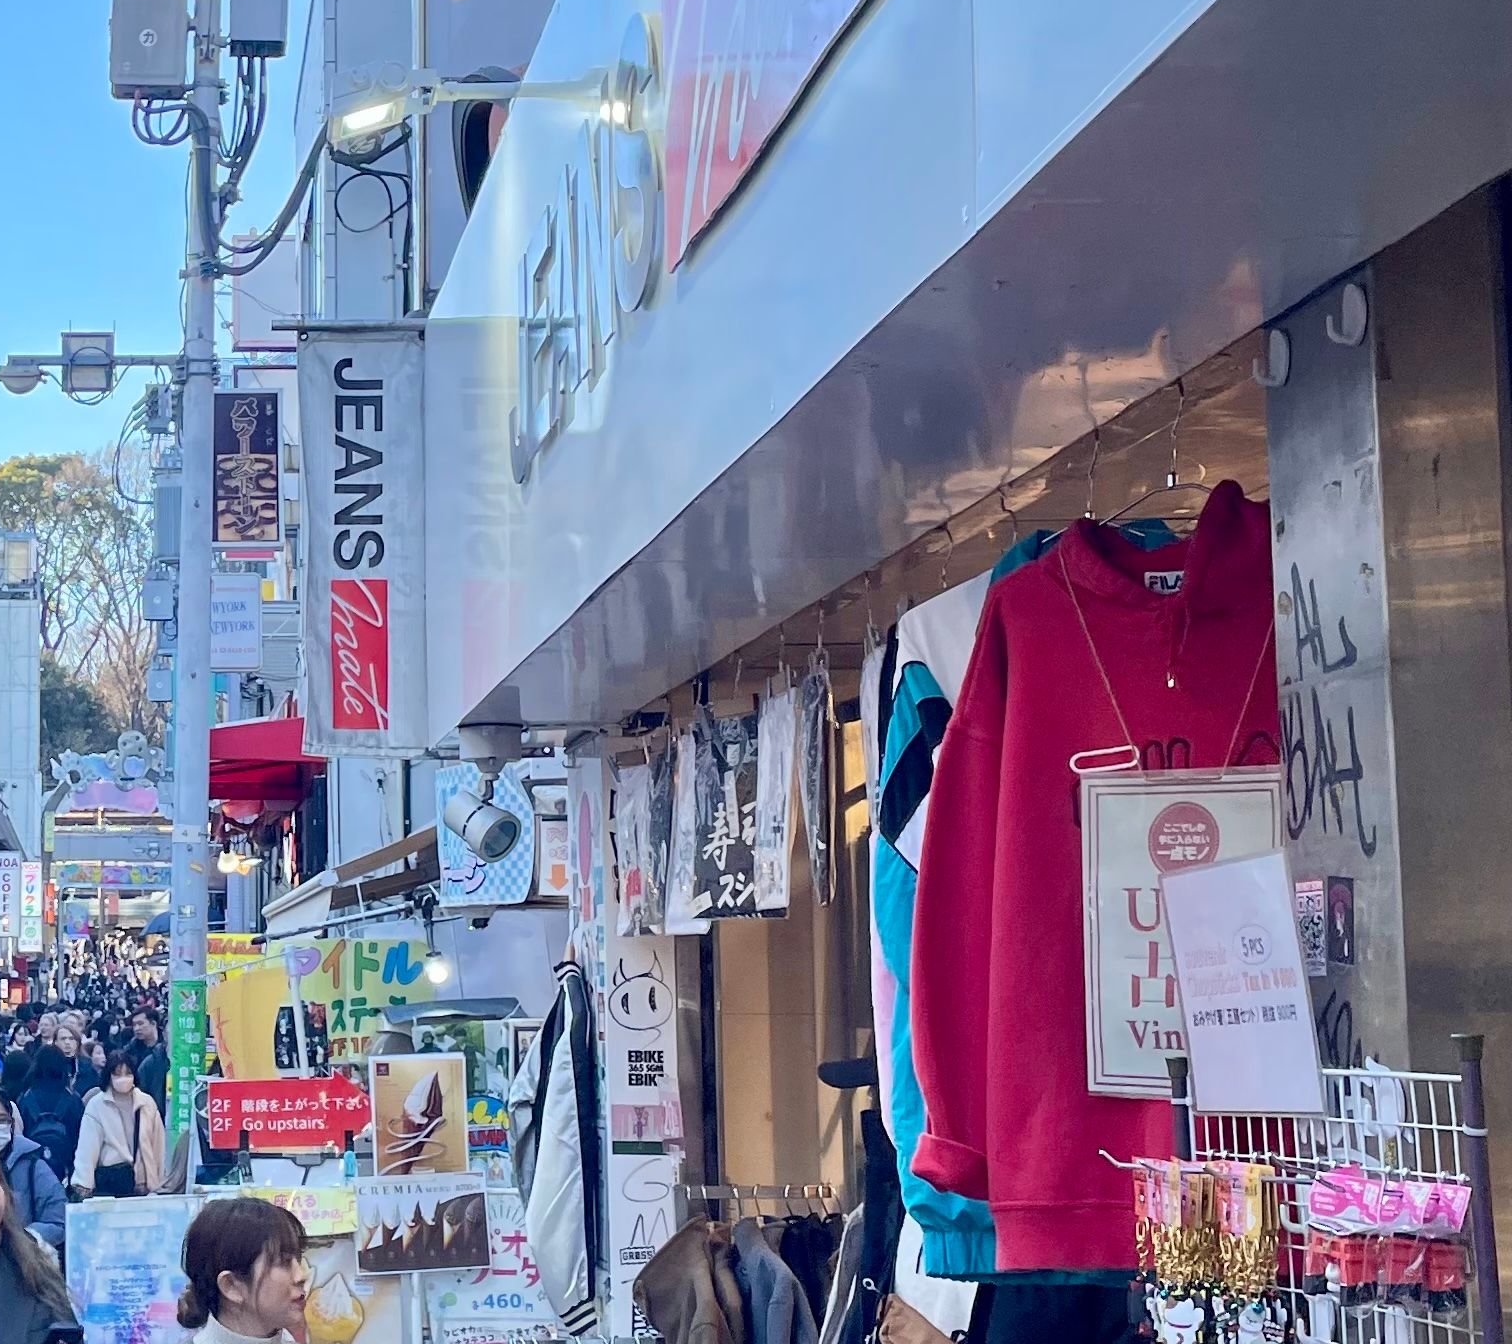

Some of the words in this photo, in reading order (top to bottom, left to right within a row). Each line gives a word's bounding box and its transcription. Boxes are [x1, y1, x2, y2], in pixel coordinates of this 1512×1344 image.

[509, 13, 665, 483] JEANS
[333, 358, 385, 570] JEANS
[212, 601, 247, 614] WYORK
[331, 579, 388, 730] mate
[1157, 847, 1210, 862] 一点モノ
[1123, 887, 1161, 932] U
[289, 939, 423, 991] アイドル
[1124, 941, 1177, 1008] 古
[1126, 1020, 1185, 1050] Vin
[628, 1050, 665, 1063] EBIKE
[629, 1074, 665, 1087] EBIK
[211, 1098, 232, 1114] 2F
[241, 1097, 370, 1115] 階段を上がって下さい
[212, 1117, 233, 1133] 2F
[242, 1117, 264, 1133] Go
[267, 1116, 325, 1137] upstairs
[358, 1182, 424, 1195] CREMIA
